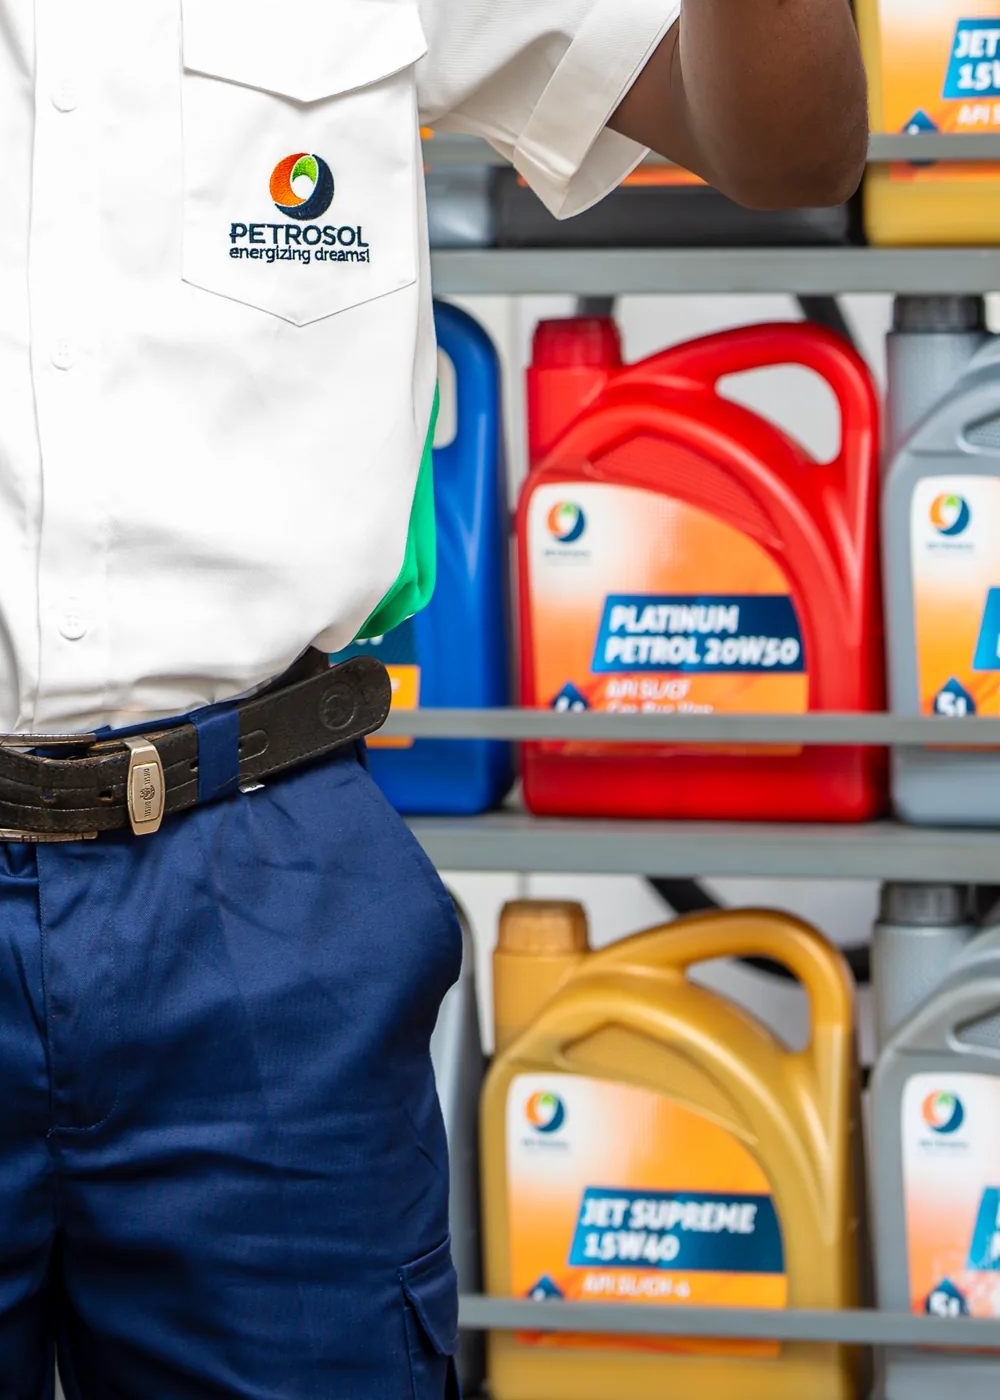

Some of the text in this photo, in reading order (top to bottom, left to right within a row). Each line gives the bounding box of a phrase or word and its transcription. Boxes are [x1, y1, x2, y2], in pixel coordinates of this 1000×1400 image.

[954, 29, 1000, 58] JET
[957, 60, 1000, 91] 15
[229, 222, 370, 247] PETROSOL
[229, 245, 370, 264] energizing dreams!
[609, 604, 740, 634] PLATINUM
[604, 634, 800, 666] PETROL 20W50
[581, 1198, 758, 1234] JET SUPREME
